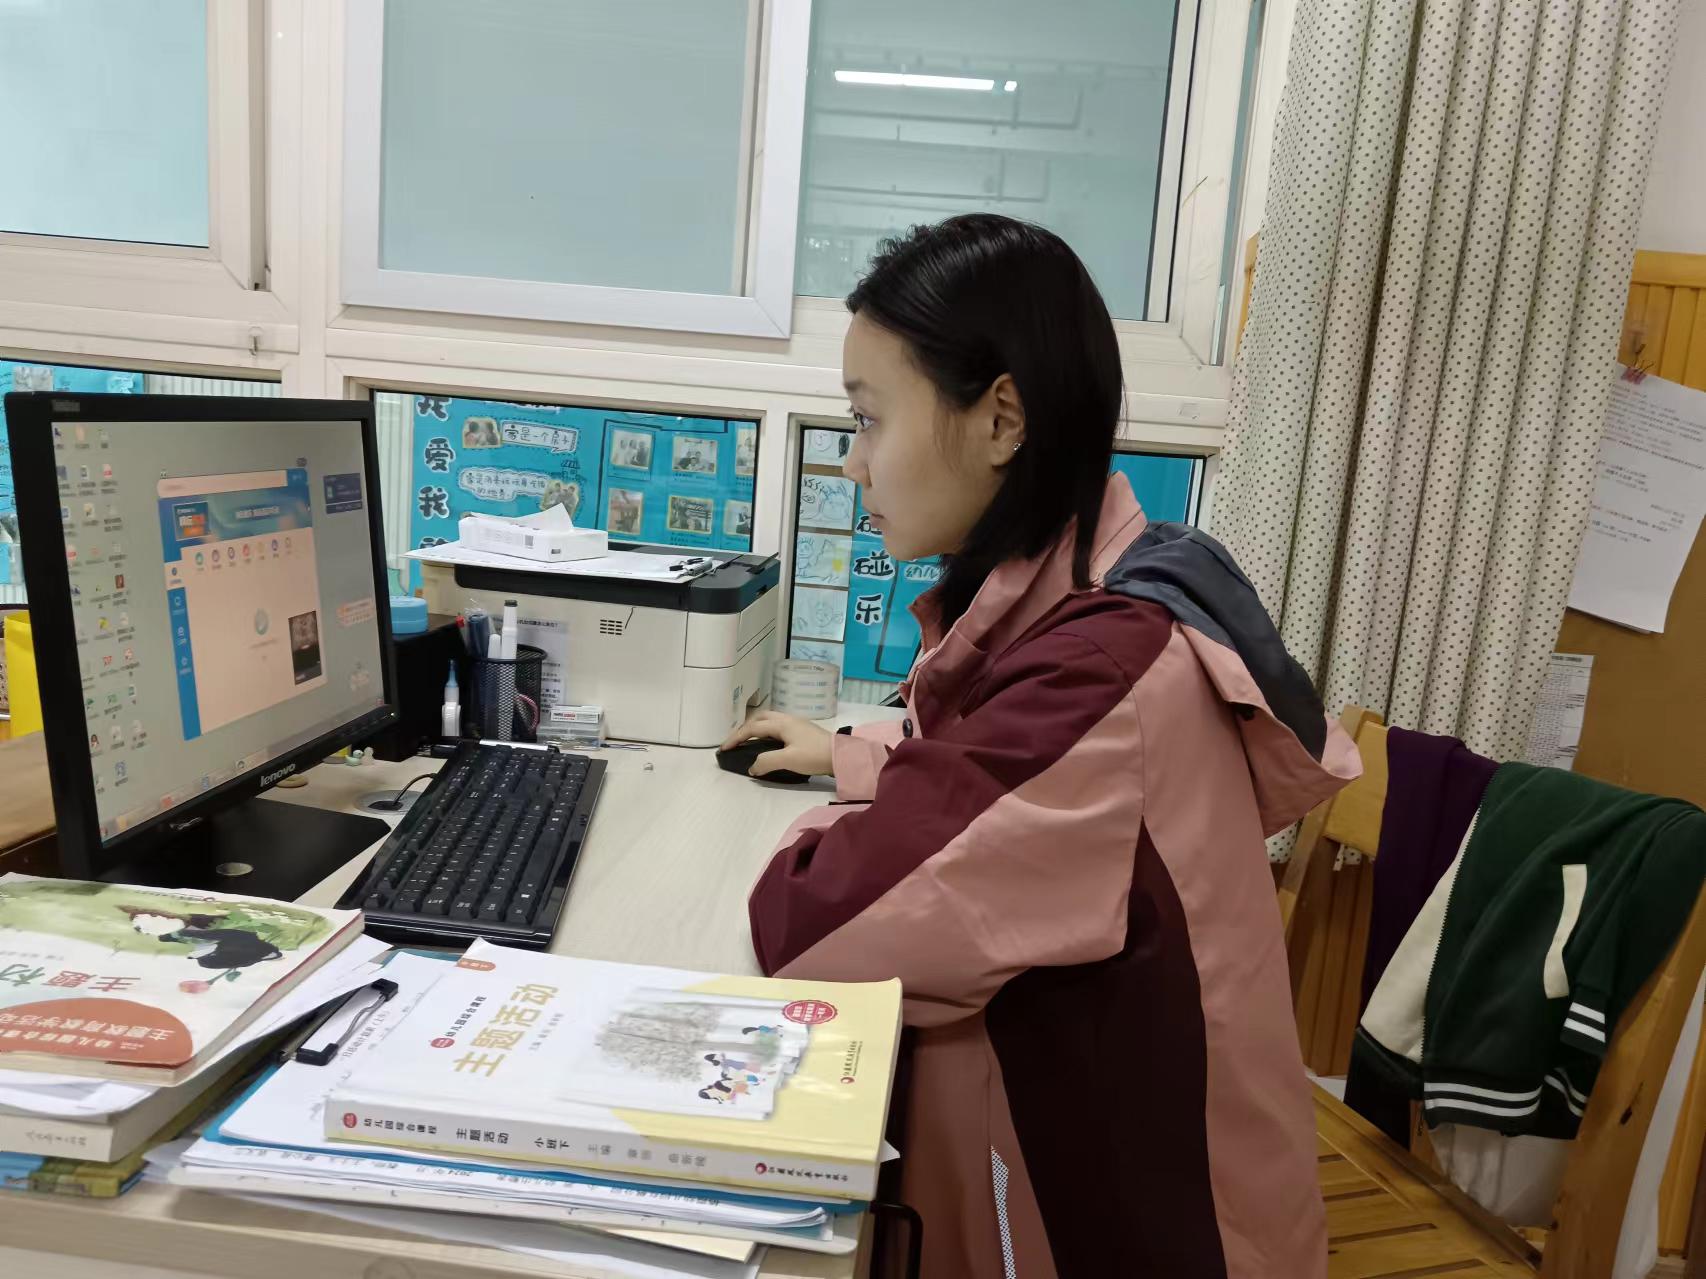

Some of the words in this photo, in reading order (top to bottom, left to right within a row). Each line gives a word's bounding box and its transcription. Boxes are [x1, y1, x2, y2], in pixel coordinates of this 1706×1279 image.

[417, 396, 455, 549] 我爱我
[260, 763, 296, 787] lenovo
[0, 1028, 113, 1048] 幼儿园综合课
[452, 984, 559, 1077] 主题活动
[363, 1118, 438, 1135] 幼儿园综合课程
[456, 1127, 509, 1144] 主题活动
[534, 1137, 570, 1150] 小班下
